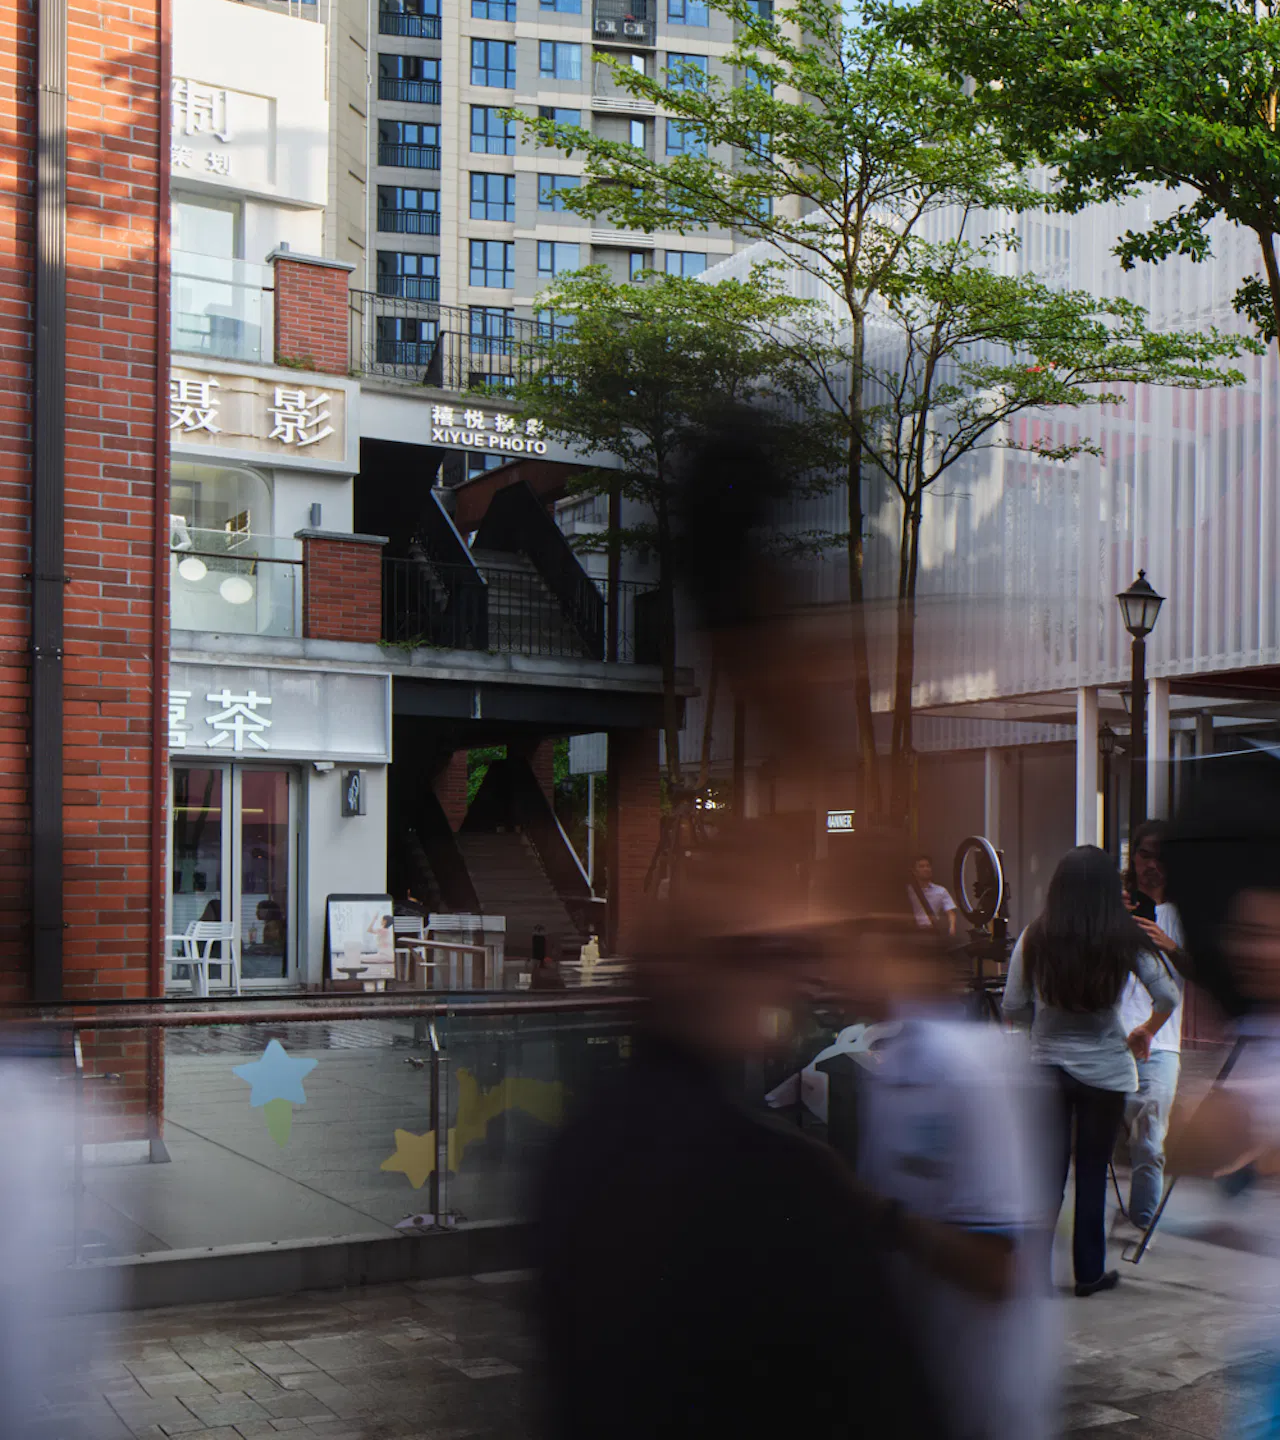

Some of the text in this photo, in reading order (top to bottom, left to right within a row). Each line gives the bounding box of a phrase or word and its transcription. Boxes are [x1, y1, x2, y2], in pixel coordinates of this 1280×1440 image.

[170, 378, 336, 448] 摄影
[432, 428, 547, 455] XIYUE PHOTO
